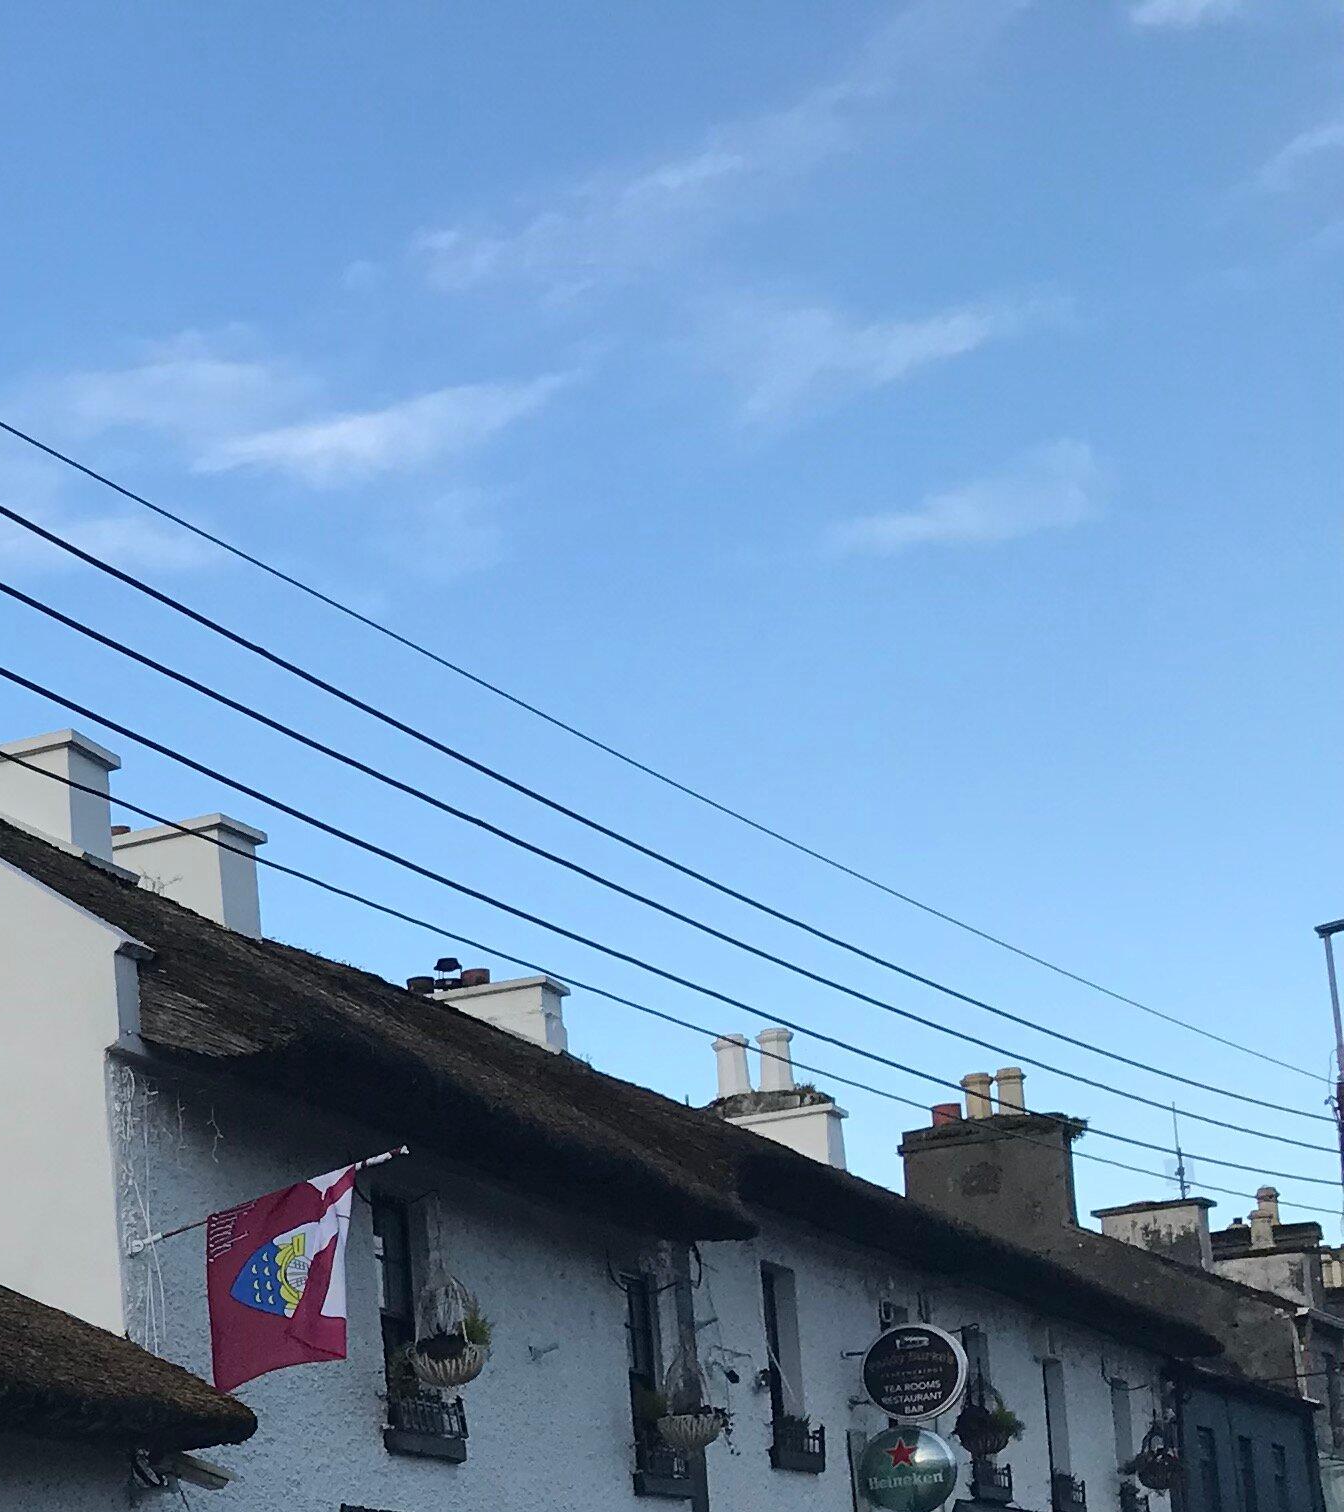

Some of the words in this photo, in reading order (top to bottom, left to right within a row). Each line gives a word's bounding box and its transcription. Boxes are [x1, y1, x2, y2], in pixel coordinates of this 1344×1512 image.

[884, 1384, 903, 1394] TEA
[904, 1380, 941, 1391] ROOMS
[880, 1391, 943, 1404] RESTAURANT
[904, 1405, 924, 1414] BAR
[868, 1469, 944, 1490] Heineken
